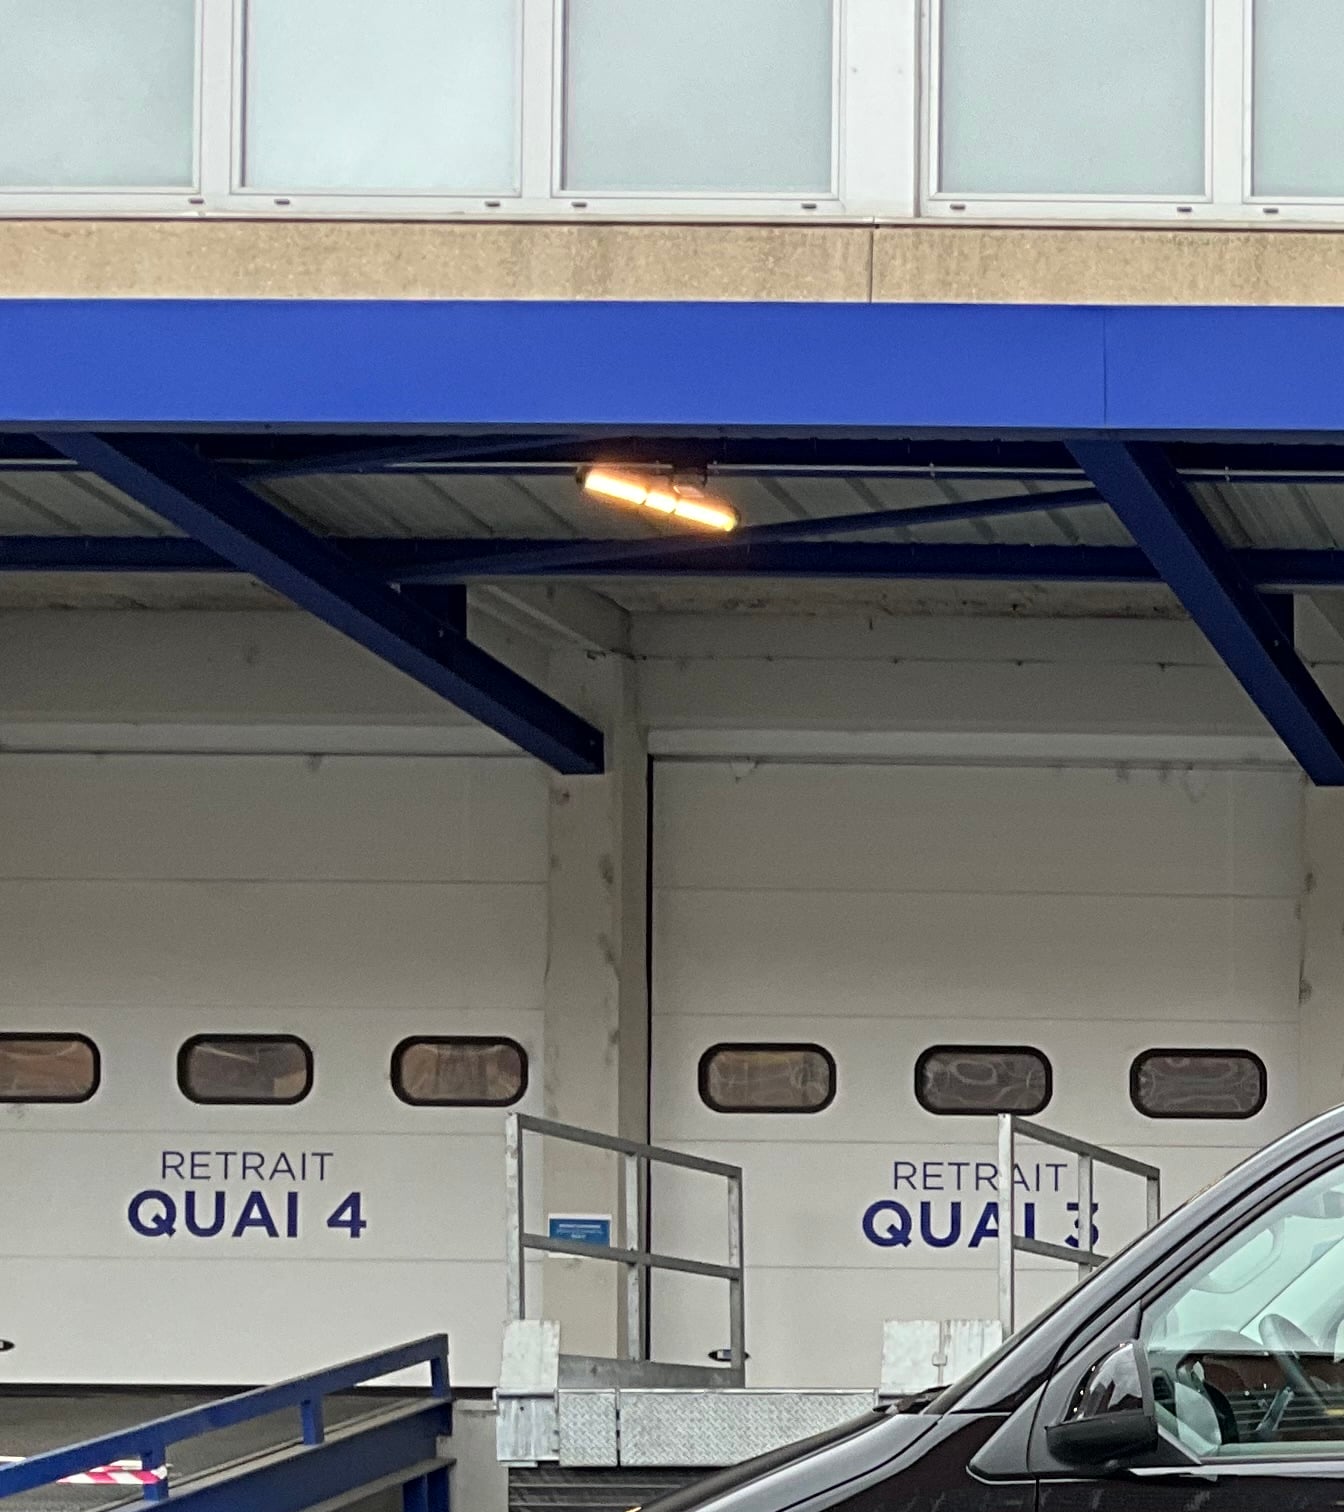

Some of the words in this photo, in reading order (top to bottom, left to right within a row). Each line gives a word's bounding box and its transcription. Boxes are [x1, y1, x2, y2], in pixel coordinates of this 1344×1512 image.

[161, 1151, 334, 1181] RETRAIT
[893, 1161, 1068, 1192] RETRAIT
[127, 1189, 299, 1238] QUAI
[326, 1191, 367, 1238] 4
[862, 1200, 1036, 1248] QUAI
[1064, 1202, 1100, 1249] 3
